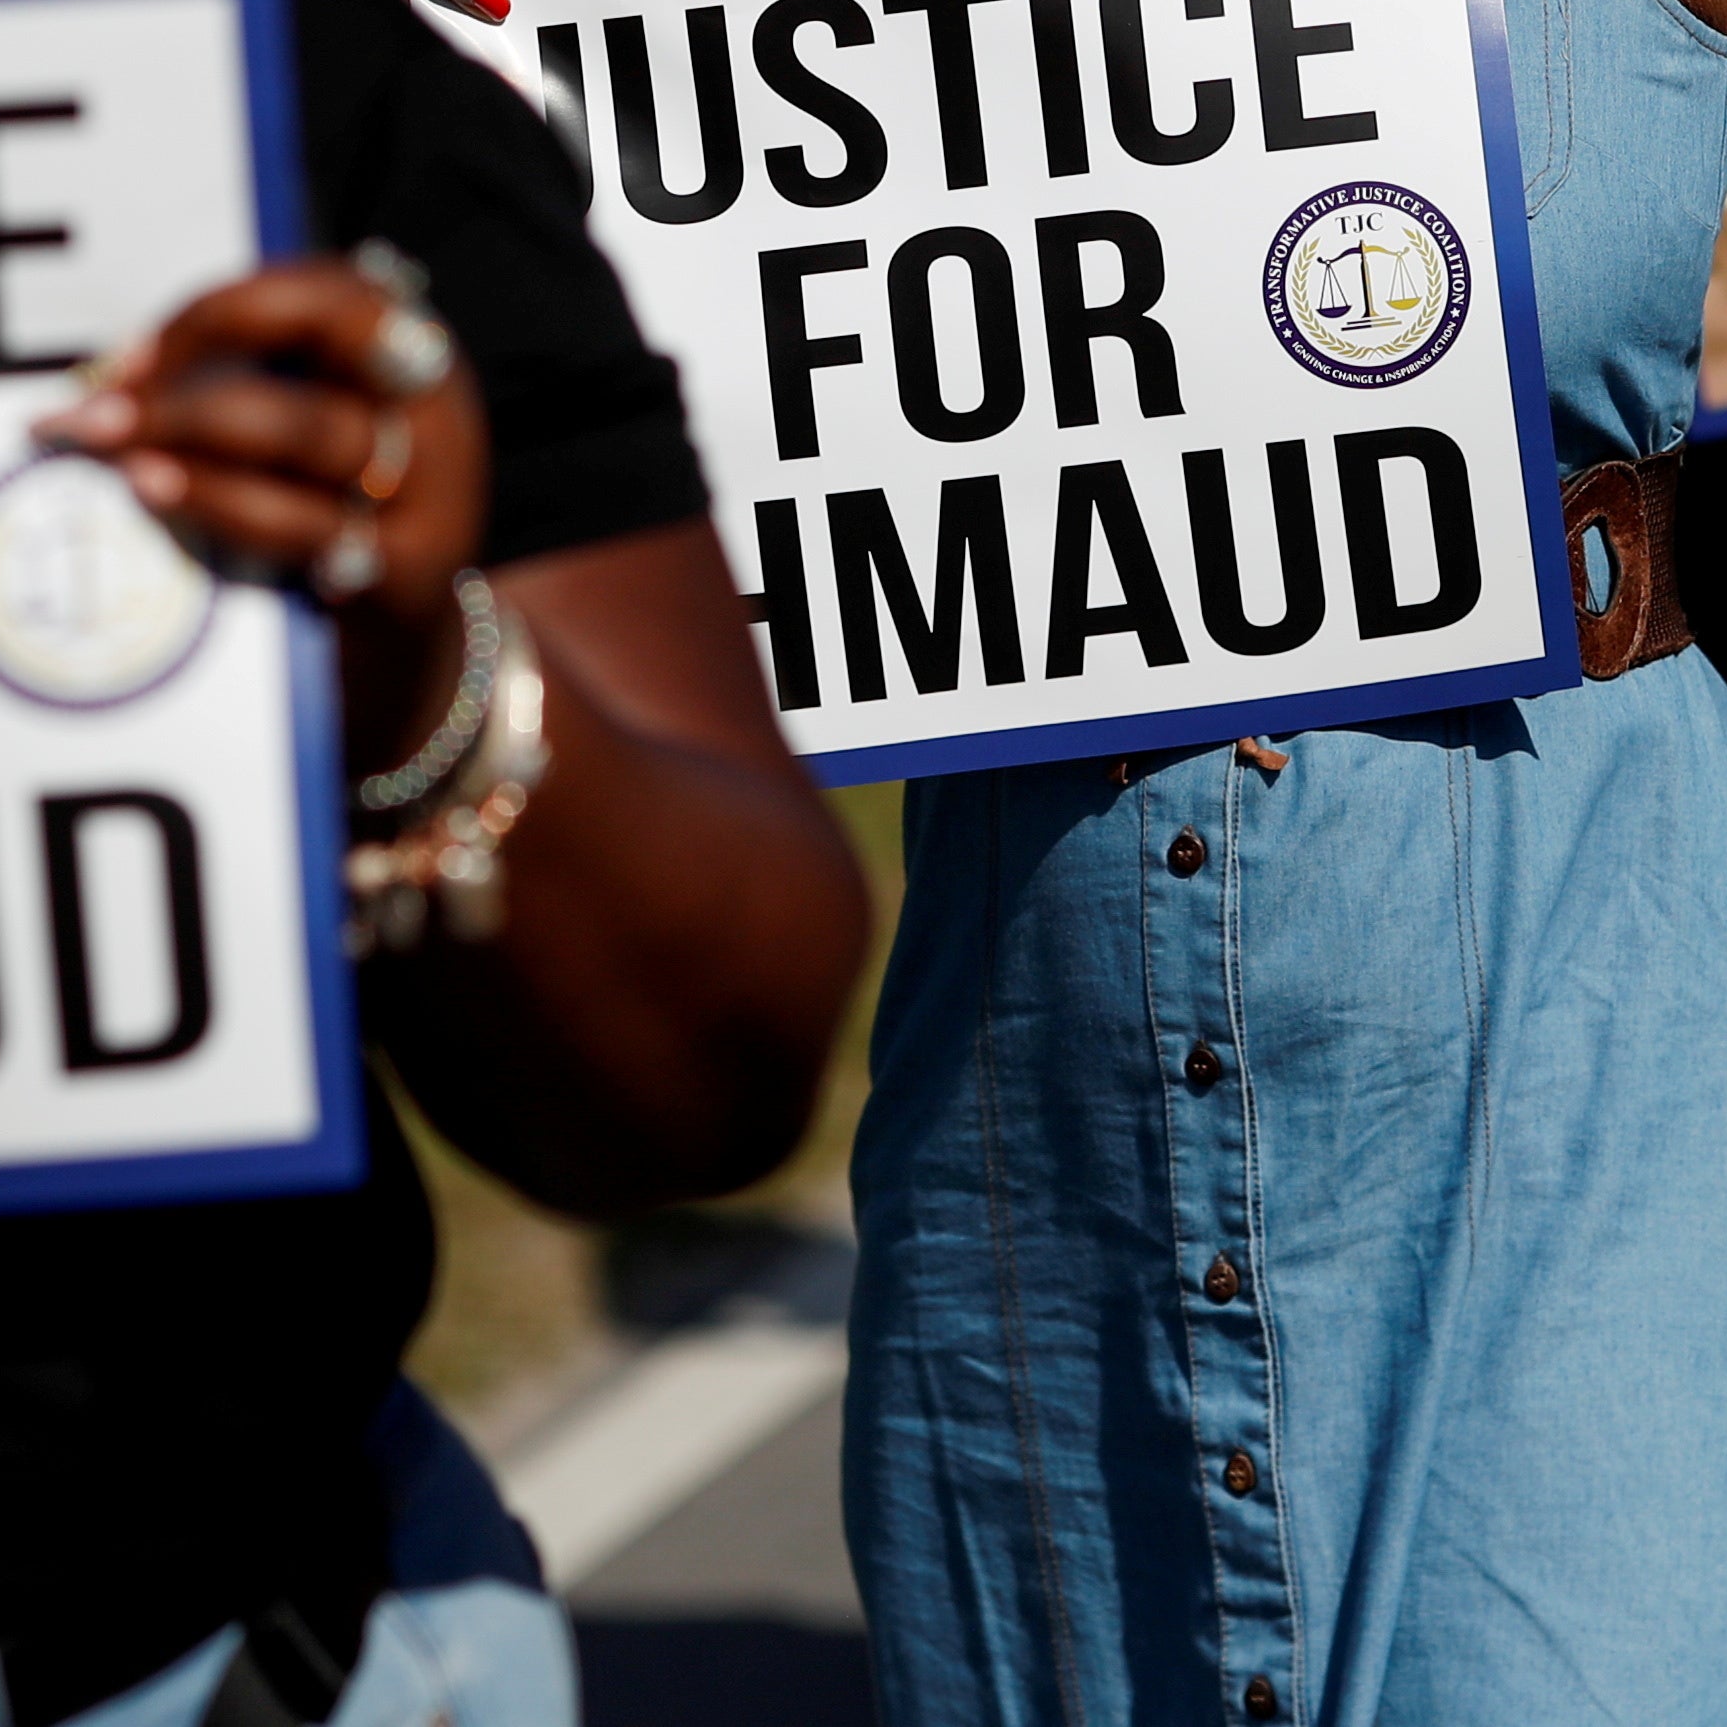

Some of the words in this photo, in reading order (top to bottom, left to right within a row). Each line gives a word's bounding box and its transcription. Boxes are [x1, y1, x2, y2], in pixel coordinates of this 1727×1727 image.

[1268, 190, 1348, 327] TRANSFORMATIVE
[1353, 187, 1424, 216] JUSTICE
[1423, 212, 1466, 305] COALITION
[1335, 212, 1384, 235] TJC
[758, 210, 1186, 461] FOR
[1292, 341, 1332, 374] IGNITING
[1332, 370, 1373, 384] CHANGE
[1376, 374, 1384, 384] &
[1384, 353, 1432, 382] INSPIRING
[1430, 321, 1457, 357] ACTION
